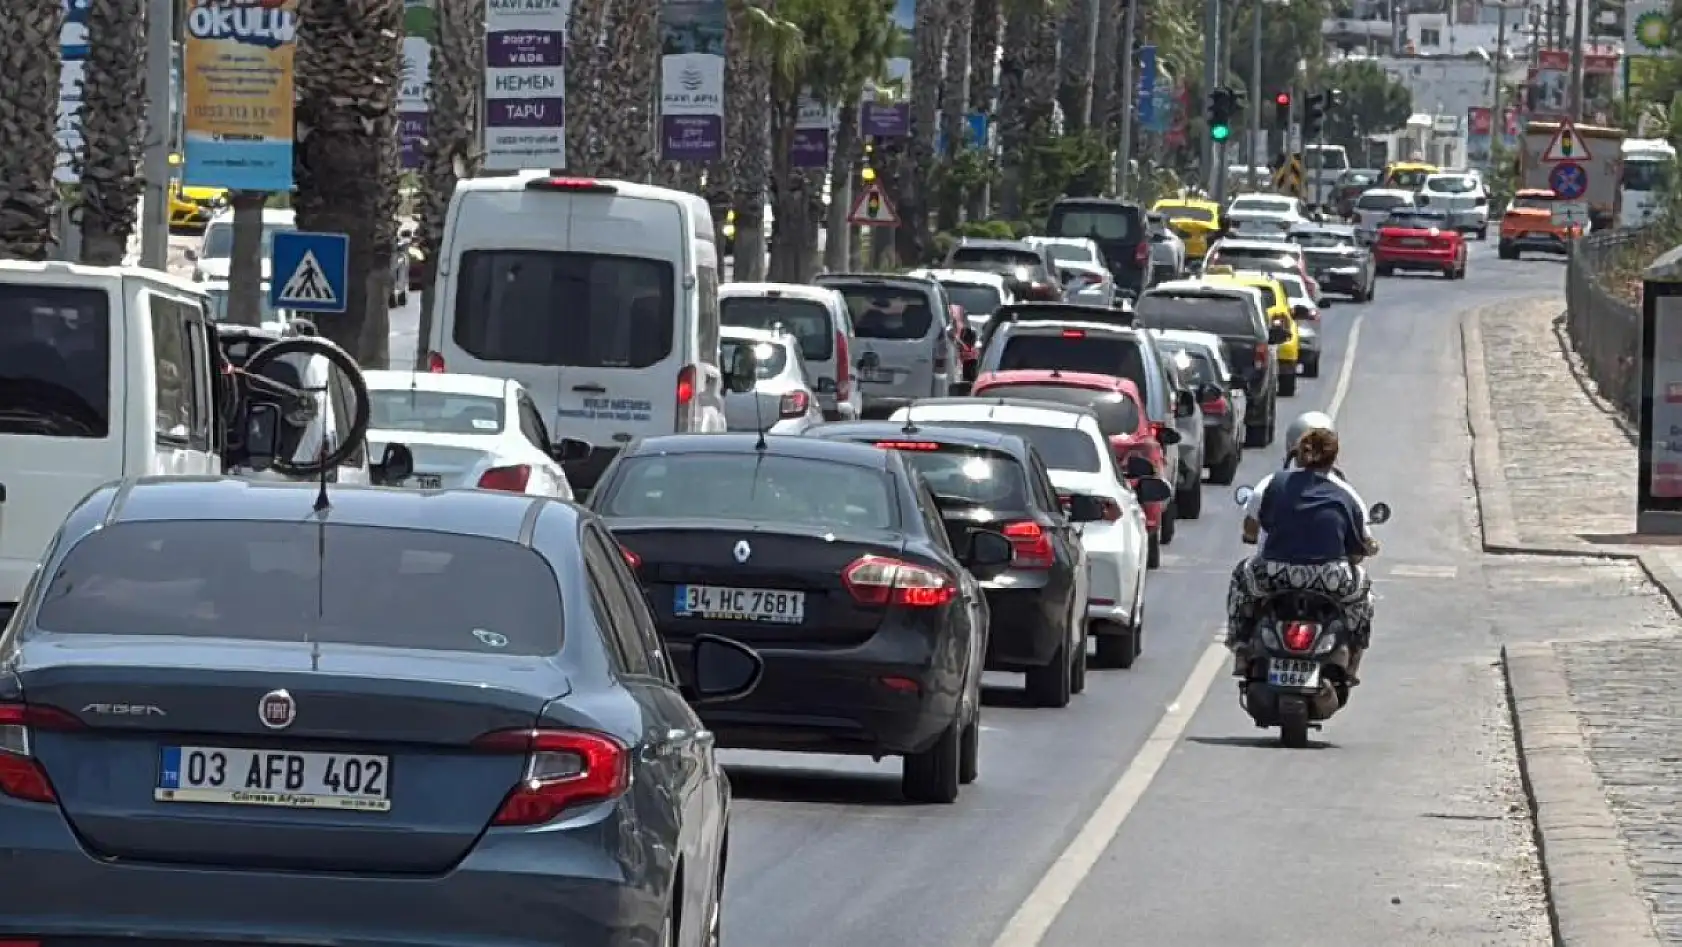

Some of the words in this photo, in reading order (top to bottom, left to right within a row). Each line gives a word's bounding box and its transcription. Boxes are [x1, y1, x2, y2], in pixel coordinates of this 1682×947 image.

[190, 6, 293, 40] OKULU
[495, 75, 554, 91] HEMEN
[505, 104, 544, 119] TAPU
[688, 588, 711, 610] 34
[720, 589, 744, 611] HC
[750, 591, 798, 615] 7681
[187, 751, 228, 787] 03
[245, 754, 305, 791] AFB
[322, 757, 383, 796] 402
